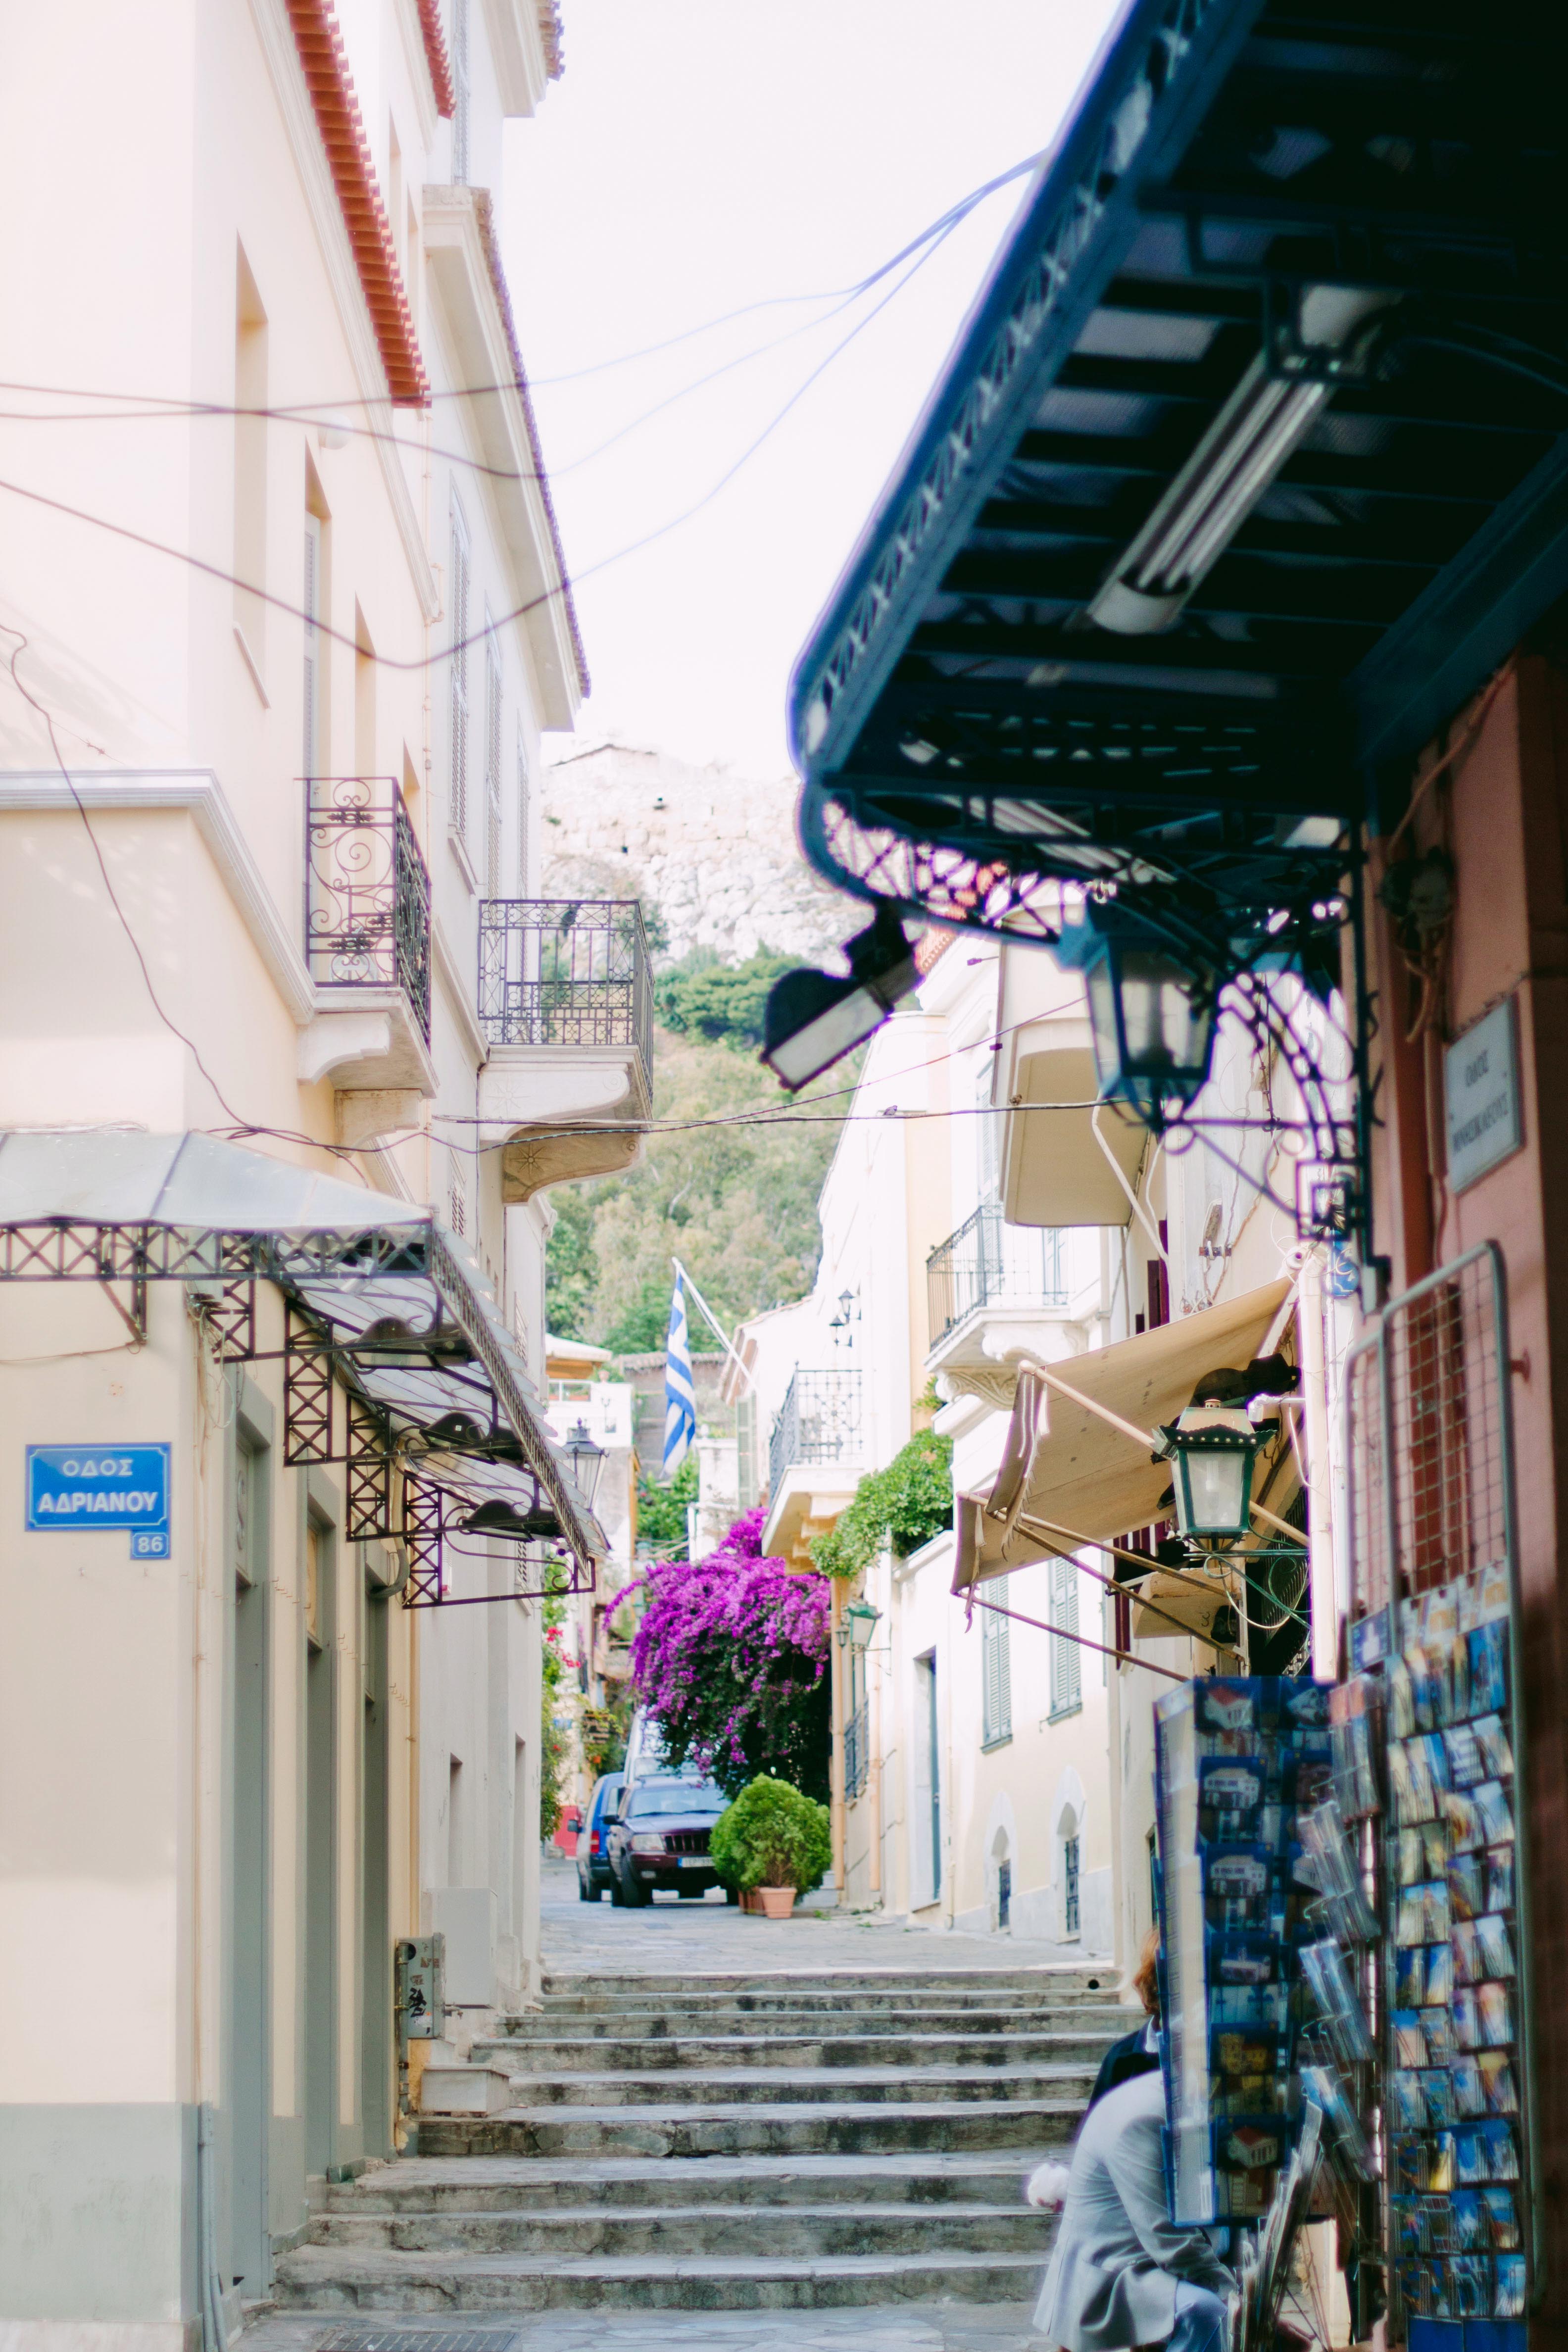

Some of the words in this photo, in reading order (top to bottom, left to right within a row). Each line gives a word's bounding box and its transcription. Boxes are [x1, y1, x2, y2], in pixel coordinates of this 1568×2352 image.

[63, 1459, 134, 1477] ΟΔΟΣ
[38, 1491, 158, 1513] ΑΔΡΙΑΝΟΥ
[138, 1536, 163, 1553] 86
